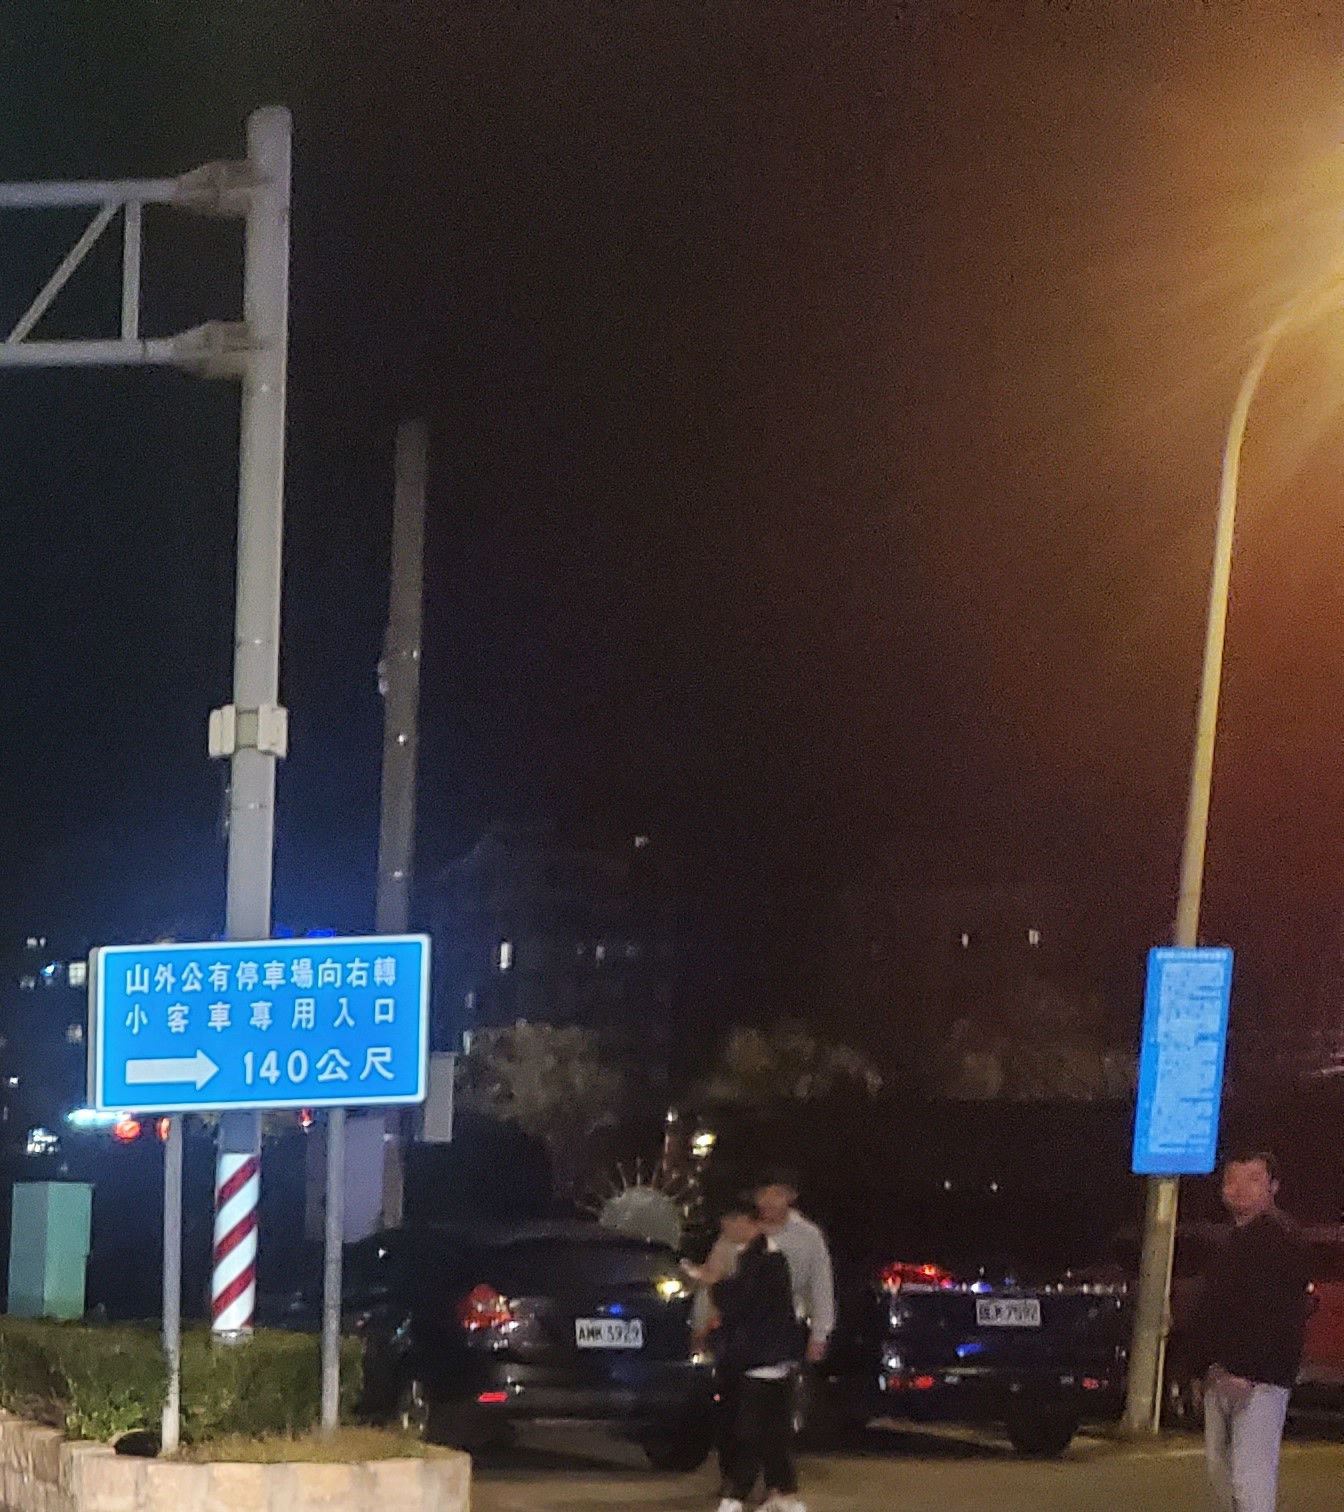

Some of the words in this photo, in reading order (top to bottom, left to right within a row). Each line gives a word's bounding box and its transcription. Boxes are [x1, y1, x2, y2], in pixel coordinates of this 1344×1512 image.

[125, 956, 397, 996] 山外公有停車場向右轉
[125, 997, 396, 1035] 小客車專用入口
[243, 1046, 396, 1086] 140公尺
